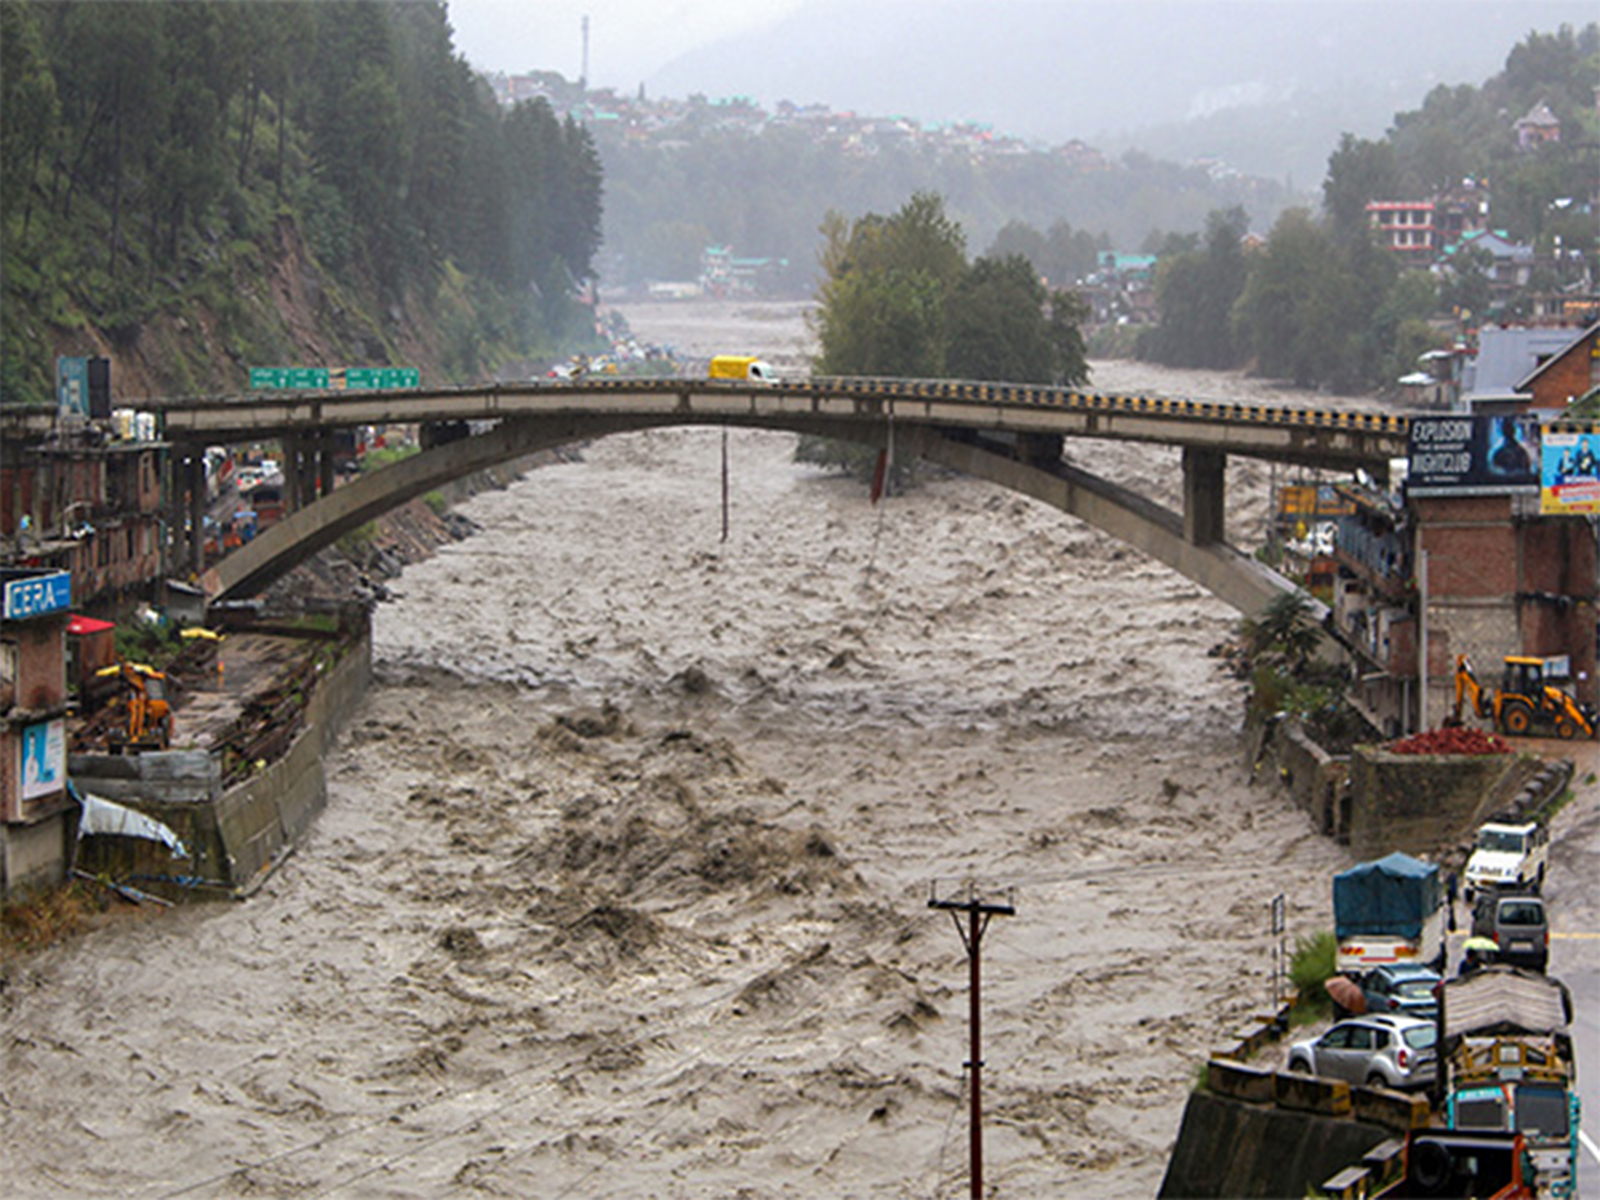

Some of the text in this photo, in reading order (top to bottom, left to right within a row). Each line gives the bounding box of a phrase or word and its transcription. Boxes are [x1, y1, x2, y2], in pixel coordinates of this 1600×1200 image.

[1412, 420, 1472, 441] EXPLOSION
[1411, 452, 1471, 472] NIGHTCLUB
[11, 582, 57, 615] CERA
